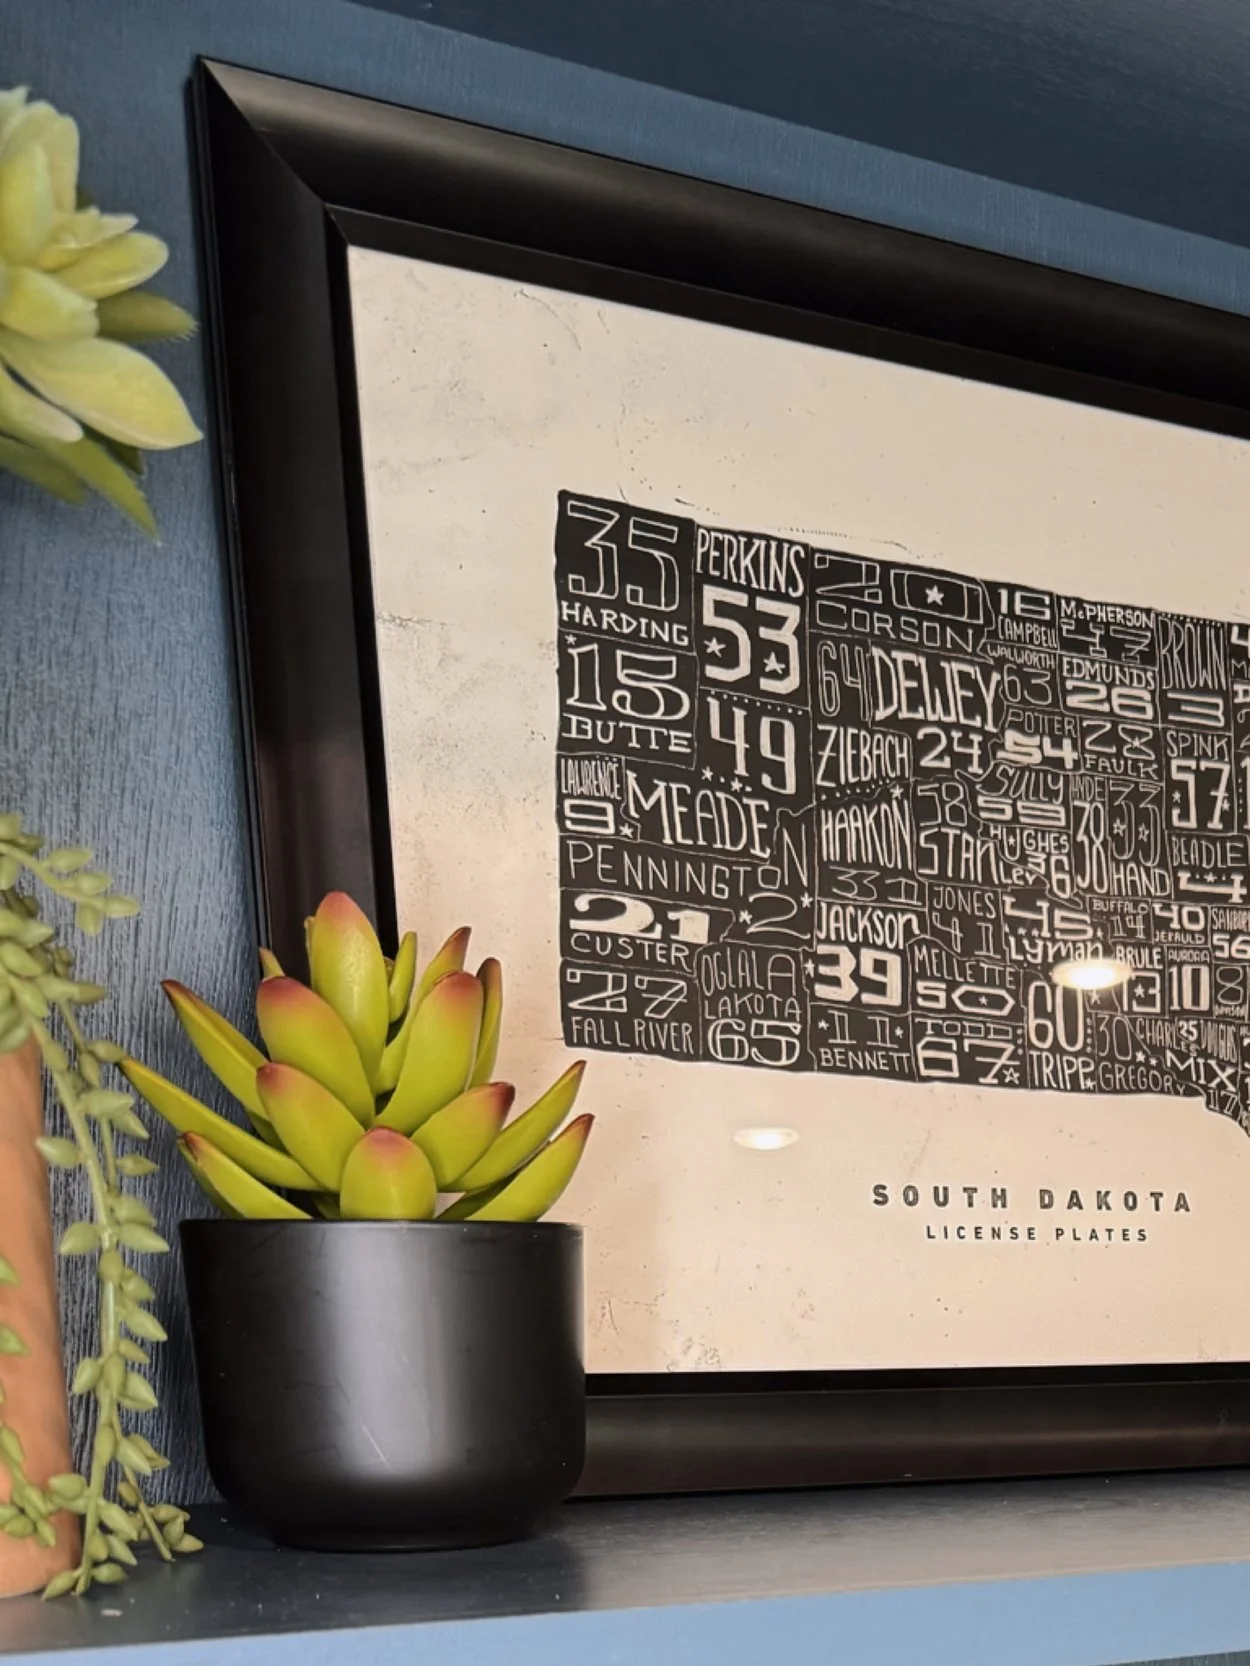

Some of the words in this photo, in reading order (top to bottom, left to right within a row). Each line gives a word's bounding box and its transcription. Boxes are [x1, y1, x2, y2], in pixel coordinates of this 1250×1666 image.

[567, 500, 680, 611] 35
[696, 528, 805, 597] PERKINS
[561, 600, 689, 646] HARDING
[998, 588, 1051, 621] 16
[702, 584, 801, 695] 53
[816, 600, 974, 653] CORSON
[998, 616, 1057, 648] CAMPBELL
[988, 644, 1055, 669] WALWORTH
[1062, 657, 1155, 690] EDMUNDS
[1159, 617, 1227, 690] BROWN
[566, 643, 690, 720] 15
[817, 640, 870, 722] 64
[871, 646, 1001, 733] DEWEY
[1003, 664, 1052, 705] 63
[1066, 679, 1154, 720] 26
[1005, 709, 1076, 737] POTTER
[1167, 692, 1225, 727] 3
[562, 713, 692, 753] BUTTE
[707, 697, 796, 795] 49
[917, 726, 984, 774] 24
[996, 729, 1079, 769] 54
[1083, 720, 1155, 760] 28
[1167, 731, 1229, 762] SPINK
[816, 723, 910, 787] ZIEBACH
[1084, 754, 1159, 779] FAULK
[561, 758, 622, 799] LAWRENCE
[1170, 759, 1231, 829] 57
[563, 800, 615, 835] 9
[626, 770, 770, 858] MEADE
[917, 782, 968, 827] 58
[977, 795, 1066, 827] 59
[821, 799, 914, 870] HAAKON
[989, 825, 1070, 861] HUGHES
[1073, 800, 1109, 893] 38
[1172, 836, 1247, 869] BEADLE
[567, 824, 808, 899] PENNINGTON
[1026, 850, 1071, 899] 36
[1113, 862, 1171, 897] HAND
[933, 887, 997, 919] JONES
[1093, 900, 1148, 914] BUFFALO
[1177, 871, 1247, 903] 4
[569, 893, 710, 944] 21
[746, 892, 811, 940] 2
[1002, 895, 1094, 940] 45
[1152, 903, 1205, 931] 40
[571, 933, 692, 972] CUSTER
[915, 945, 1016, 989] MELLETTE
[1116, 945, 1163, 969] BRULE
[566, 969, 687, 1019] 27
[702, 951, 797, 997] OGLALA
[814, 944, 902, 1006] 39
[1168, 965, 1210, 1011] 10
[1215, 966, 1244, 1005] 8
[704, 993, 802, 1022] LAKOTA
[916, 981, 1015, 1016] 50
[1028, 981, 1085, 1053] 60
[571, 1016, 630, 1047] FALL
[635, 1018, 694, 1054] RIVER
[707, 1018, 802, 1066] 65
[915, 1019, 1013, 1039] TODD
[1097, 1015, 1132, 1061] 30
[1178, 1020, 1197, 1041] 25
[820, 1048, 910, 1073] BENNETT
[917, 1037, 1020, 1085] 67
[1029, 1052, 1094, 1090] TRIPP
[1100, 1062, 1186, 1096] GREGORY
[1166, 1049, 1236, 1092] MIX
[872, 1184, 1008, 1208] SOUTH
[1039, 1189, 1191, 1212] DAKOTA
[926, 1225, 1036, 1241] LICENSE
[1055, 1228, 1147, 1242] PLATES
